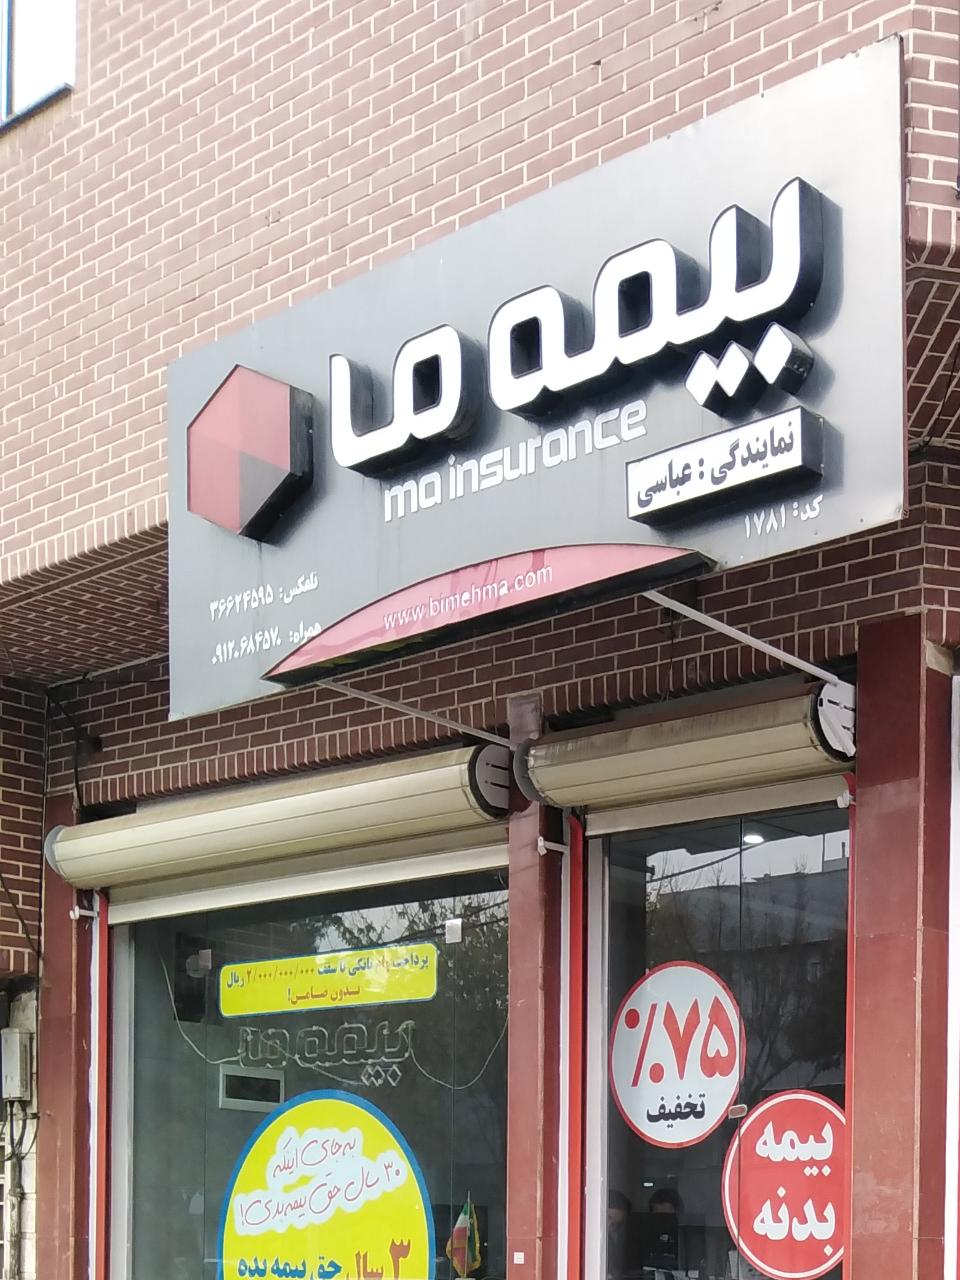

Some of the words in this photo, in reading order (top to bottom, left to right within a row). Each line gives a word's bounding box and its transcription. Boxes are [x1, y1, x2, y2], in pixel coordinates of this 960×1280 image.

[487, 176, 801, 407] بیمه
[329, 323, 464, 469] ما
[384, 471, 442, 523] ma
[447, 399, 648, 501] insurance
[637, 458, 692, 509] عباسی
[745, 503, 786, 538] ۱۷۸۱
[383, 565, 553, 630] www.bimehma.com
[227, 970, 245, 989] ریال
[645, 1092, 707, 1129] تخفیف
[383, 1160, 401, 1182] ۳۰
[754, 1119, 834, 1178] بیمه
[308, 1171, 341, 1215] حق
[344, 1167, 380, 1202] سال
[752, 1185, 837, 1257] بدنه
